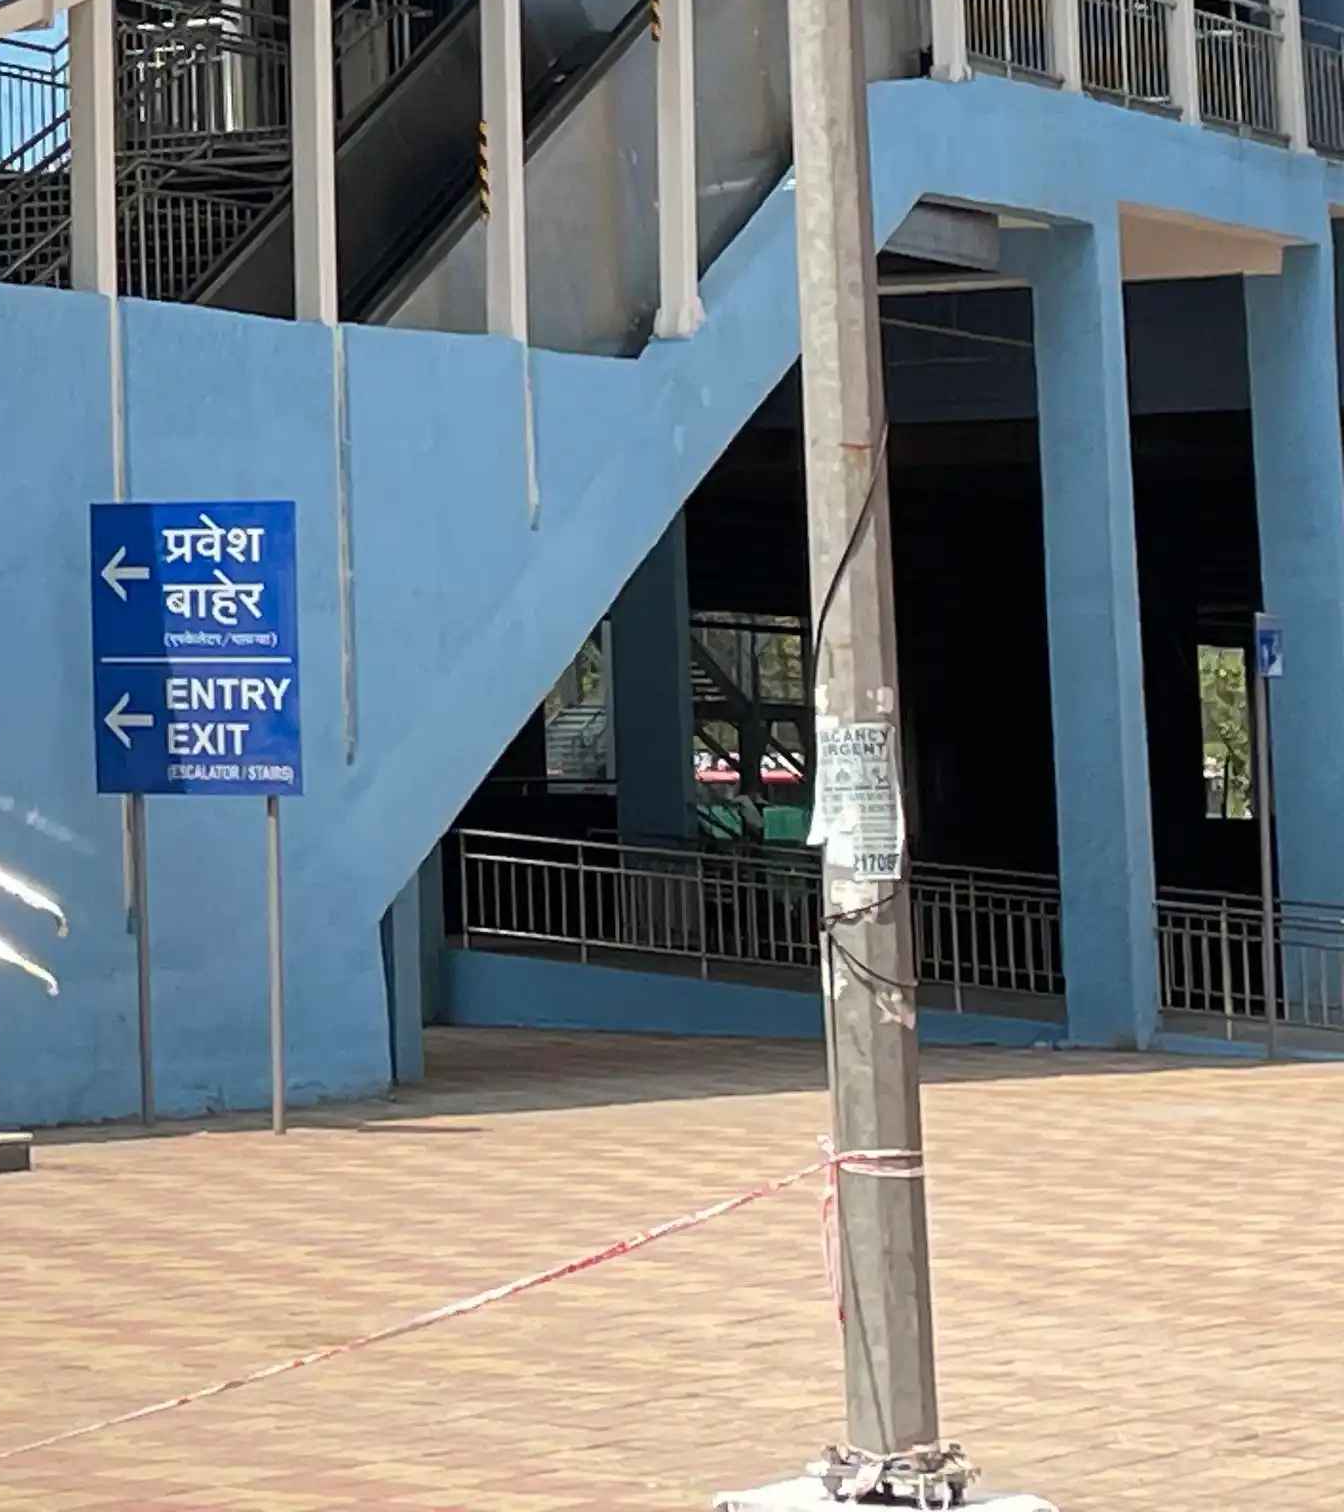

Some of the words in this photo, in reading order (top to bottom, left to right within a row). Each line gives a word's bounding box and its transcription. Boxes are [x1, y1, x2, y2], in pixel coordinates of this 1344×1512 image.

[161, 512, 265, 564] प्रवेश
[162, 568, 265, 625] बाहेर
[165, 677, 292, 711] ENTRY
[167, 722, 250, 756] EXIT
